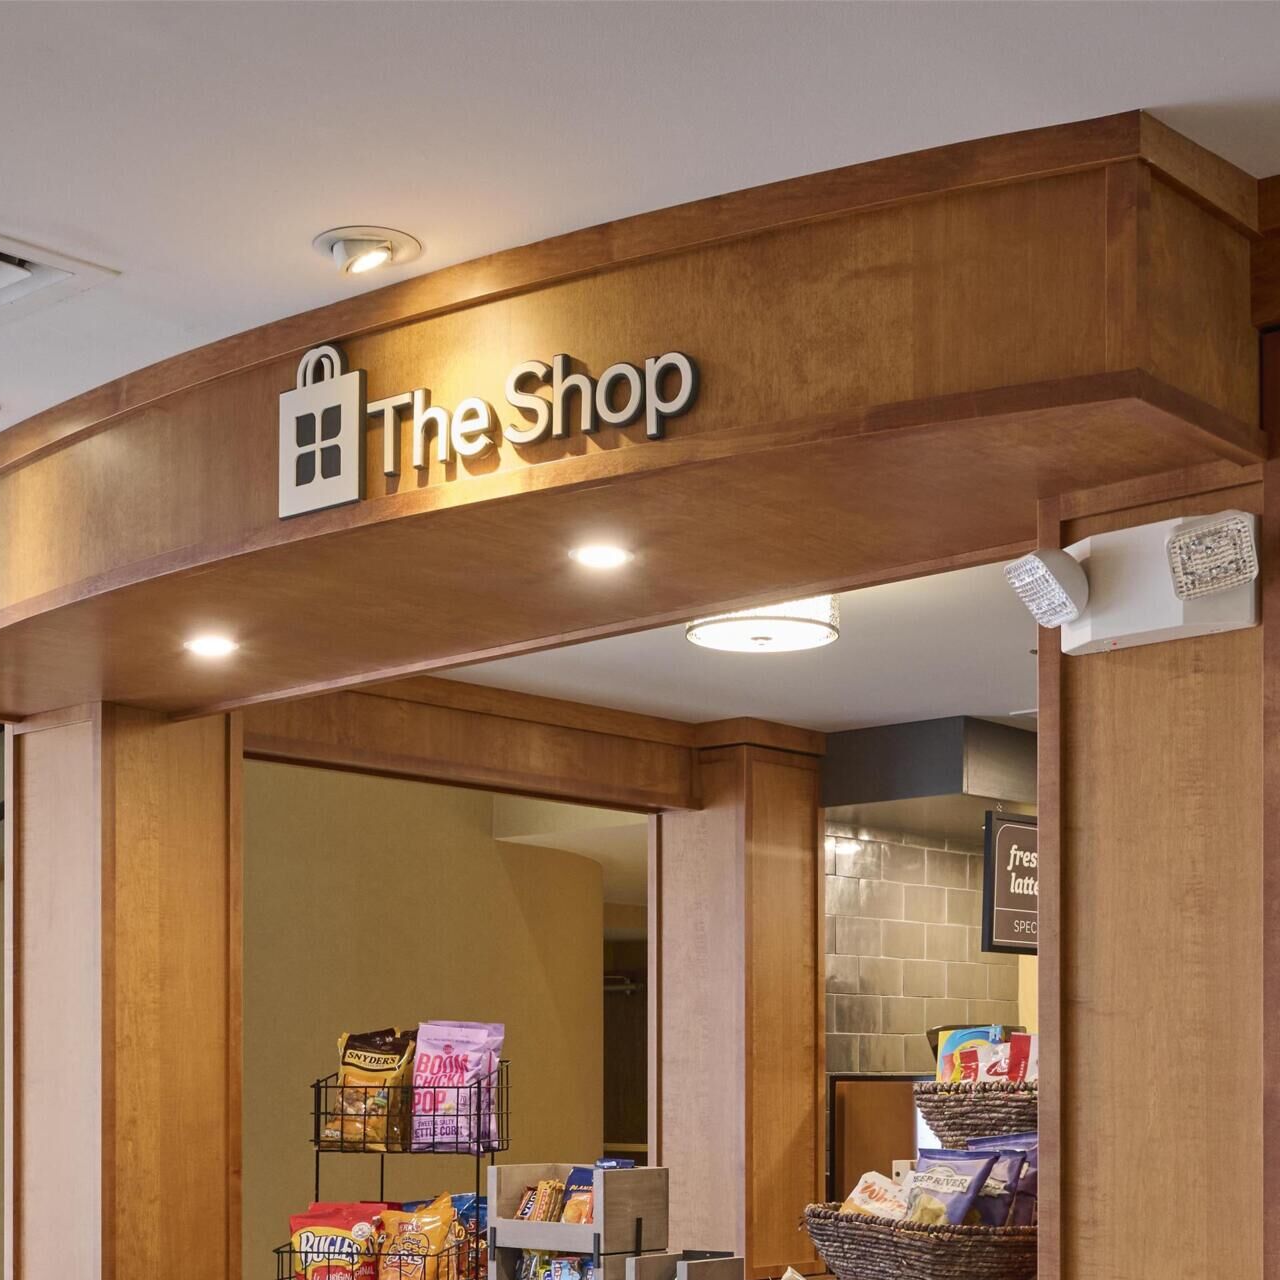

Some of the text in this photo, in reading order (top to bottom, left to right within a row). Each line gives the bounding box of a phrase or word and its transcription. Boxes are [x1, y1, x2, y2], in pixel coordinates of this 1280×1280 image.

[366, 351, 700, 478] The Shop
[1006, 844, 1039, 871] fres
[1010, 872, 1039, 896] latte
[1013, 919, 1038, 935] SPEC
[346, 1051, 397, 1065] SNYDER'S
[416, 1053, 470, 1075] BOOM
[412, 1090, 448, 1115] POP
[414, 1127, 438, 1138] ETTLE
[933, 1176, 968, 1189] RIVER
[299, 1231, 361, 1269] BUGLES
